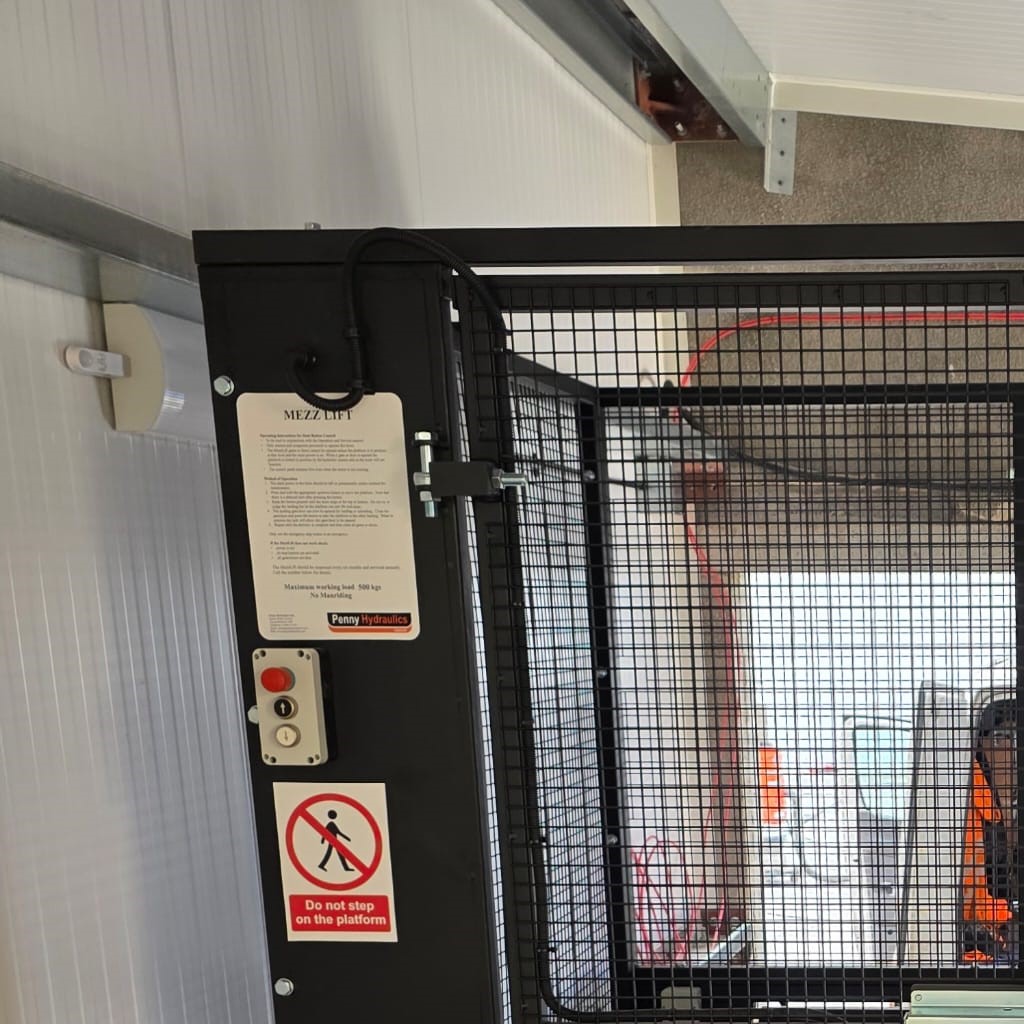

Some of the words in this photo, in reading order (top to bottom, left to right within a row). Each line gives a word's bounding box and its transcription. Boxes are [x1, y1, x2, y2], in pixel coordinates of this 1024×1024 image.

[284, 410, 321, 420] MEZZ
[324, 409, 352, 420] LIFT
[316, 583, 341, 592] working
[332, 614, 360, 626] Penny
[361, 614, 408, 626] Hydraulics
[305, 900, 322, 911] Do
[326, 901, 346, 911] not
[348, 901, 374, 913] step
[295, 915, 311, 925] on
[313, 914, 334, 925] the
[337, 914, 387, 927] platform
